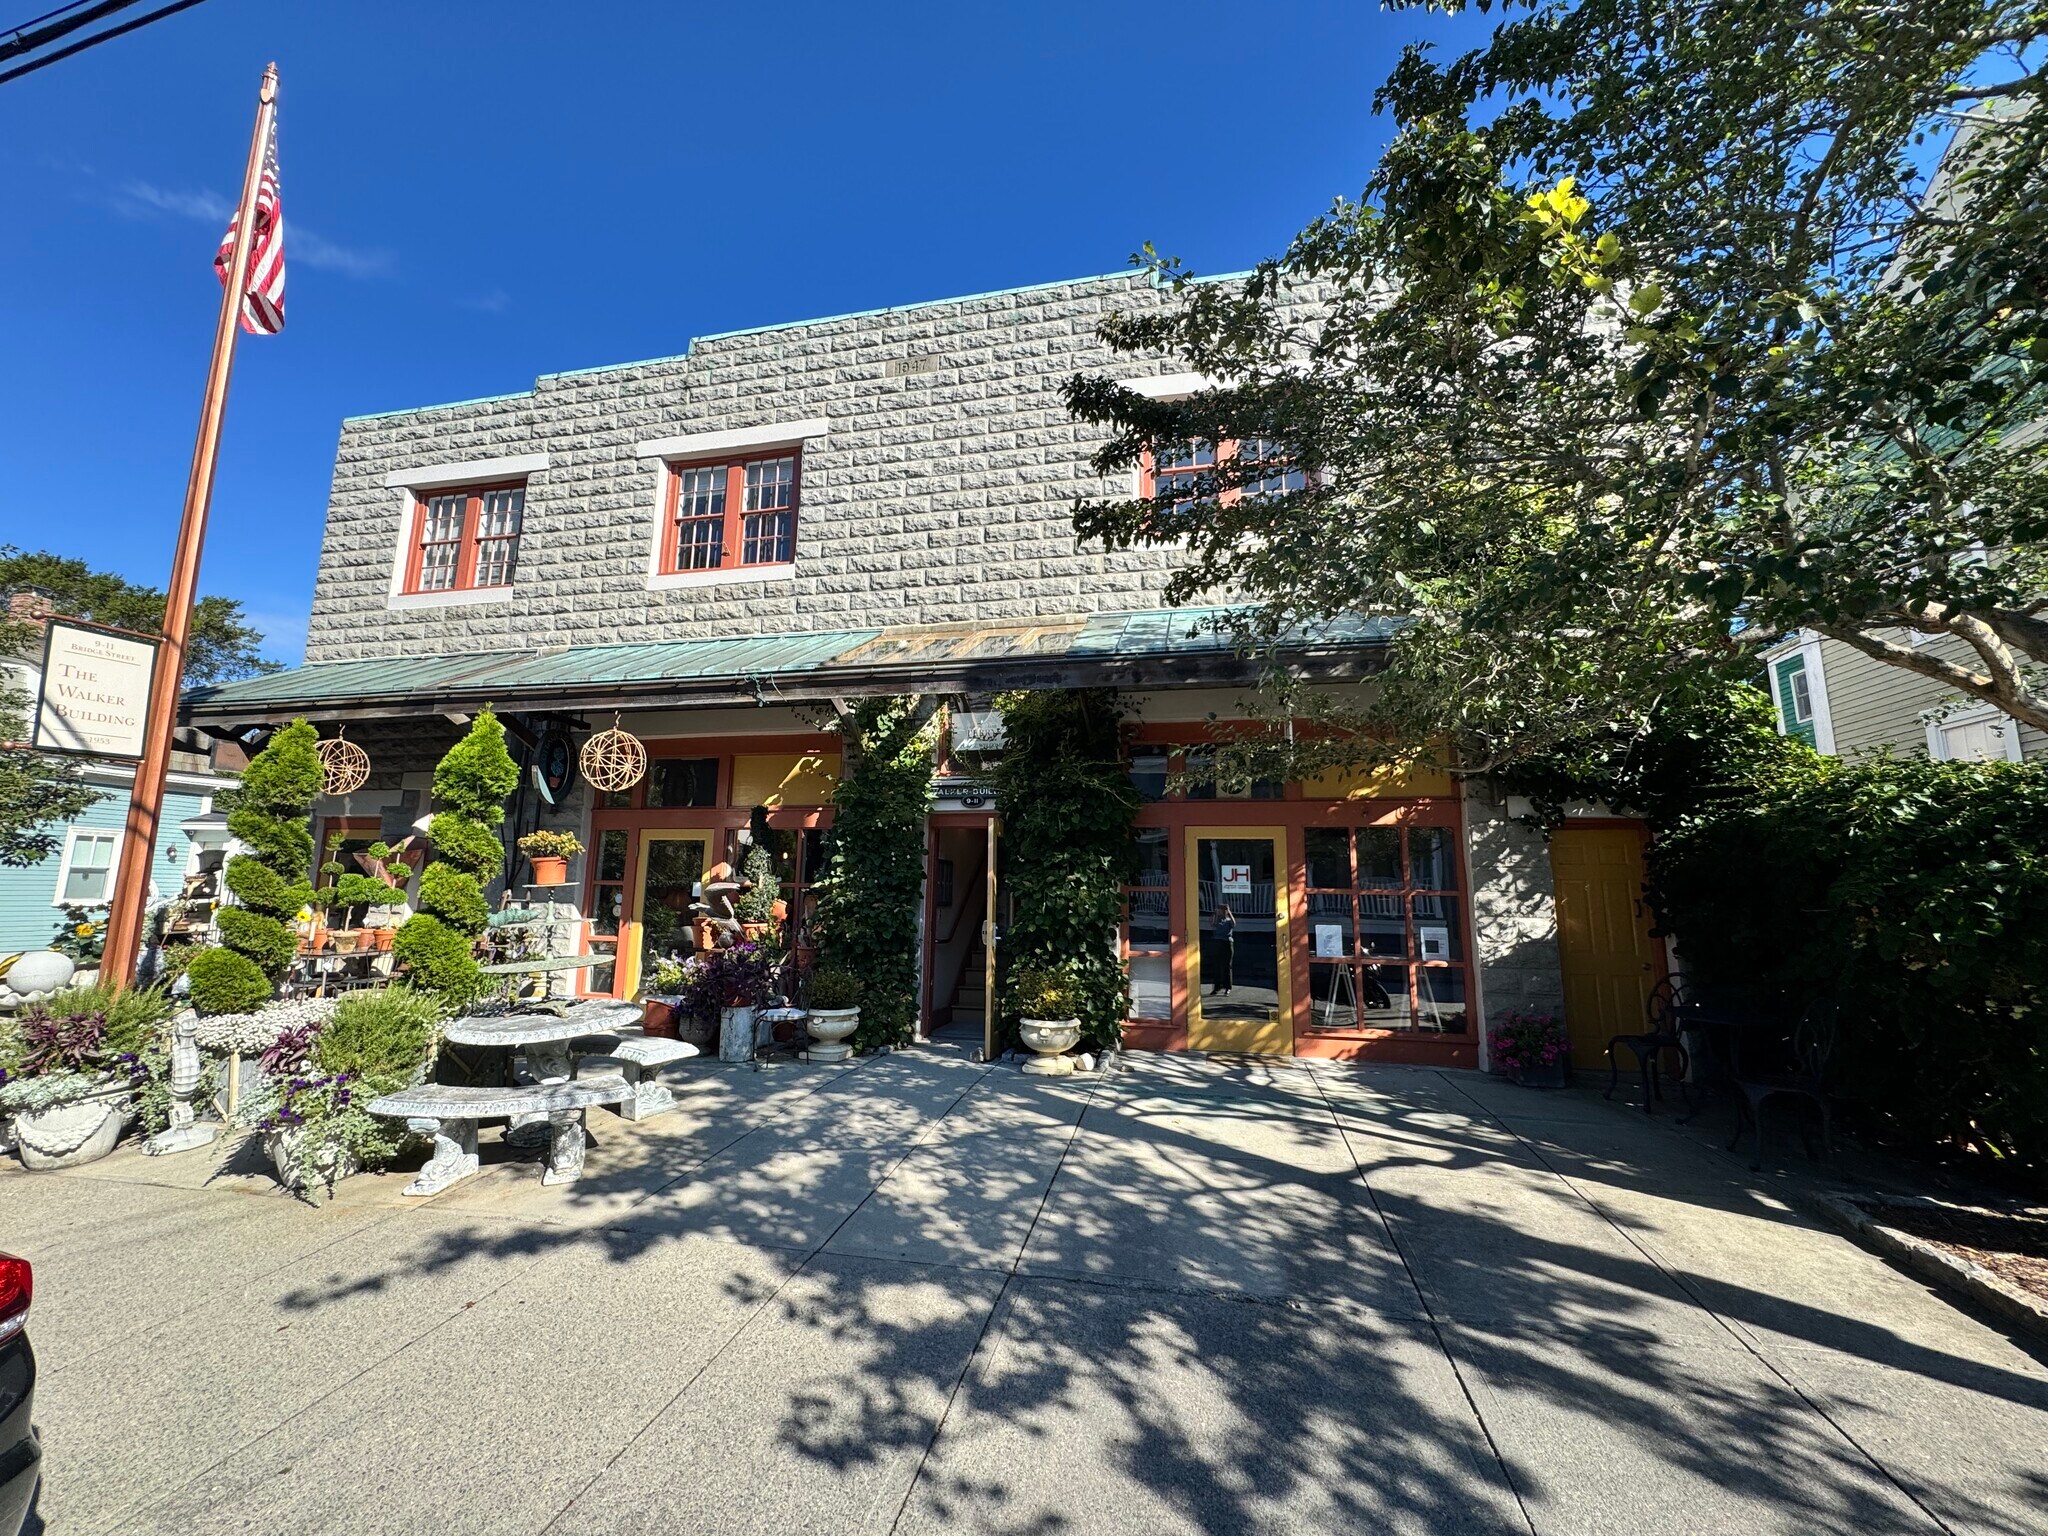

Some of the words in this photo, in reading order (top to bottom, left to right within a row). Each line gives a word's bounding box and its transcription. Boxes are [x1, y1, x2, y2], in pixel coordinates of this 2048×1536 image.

[104, 650, 135, 661] STREET
[58, 663, 97, 682] THE
[57, 683, 125, 706] WALKER
[55, 703, 135, 727] BUILDING
[1223, 868, 1249, 882] JH
